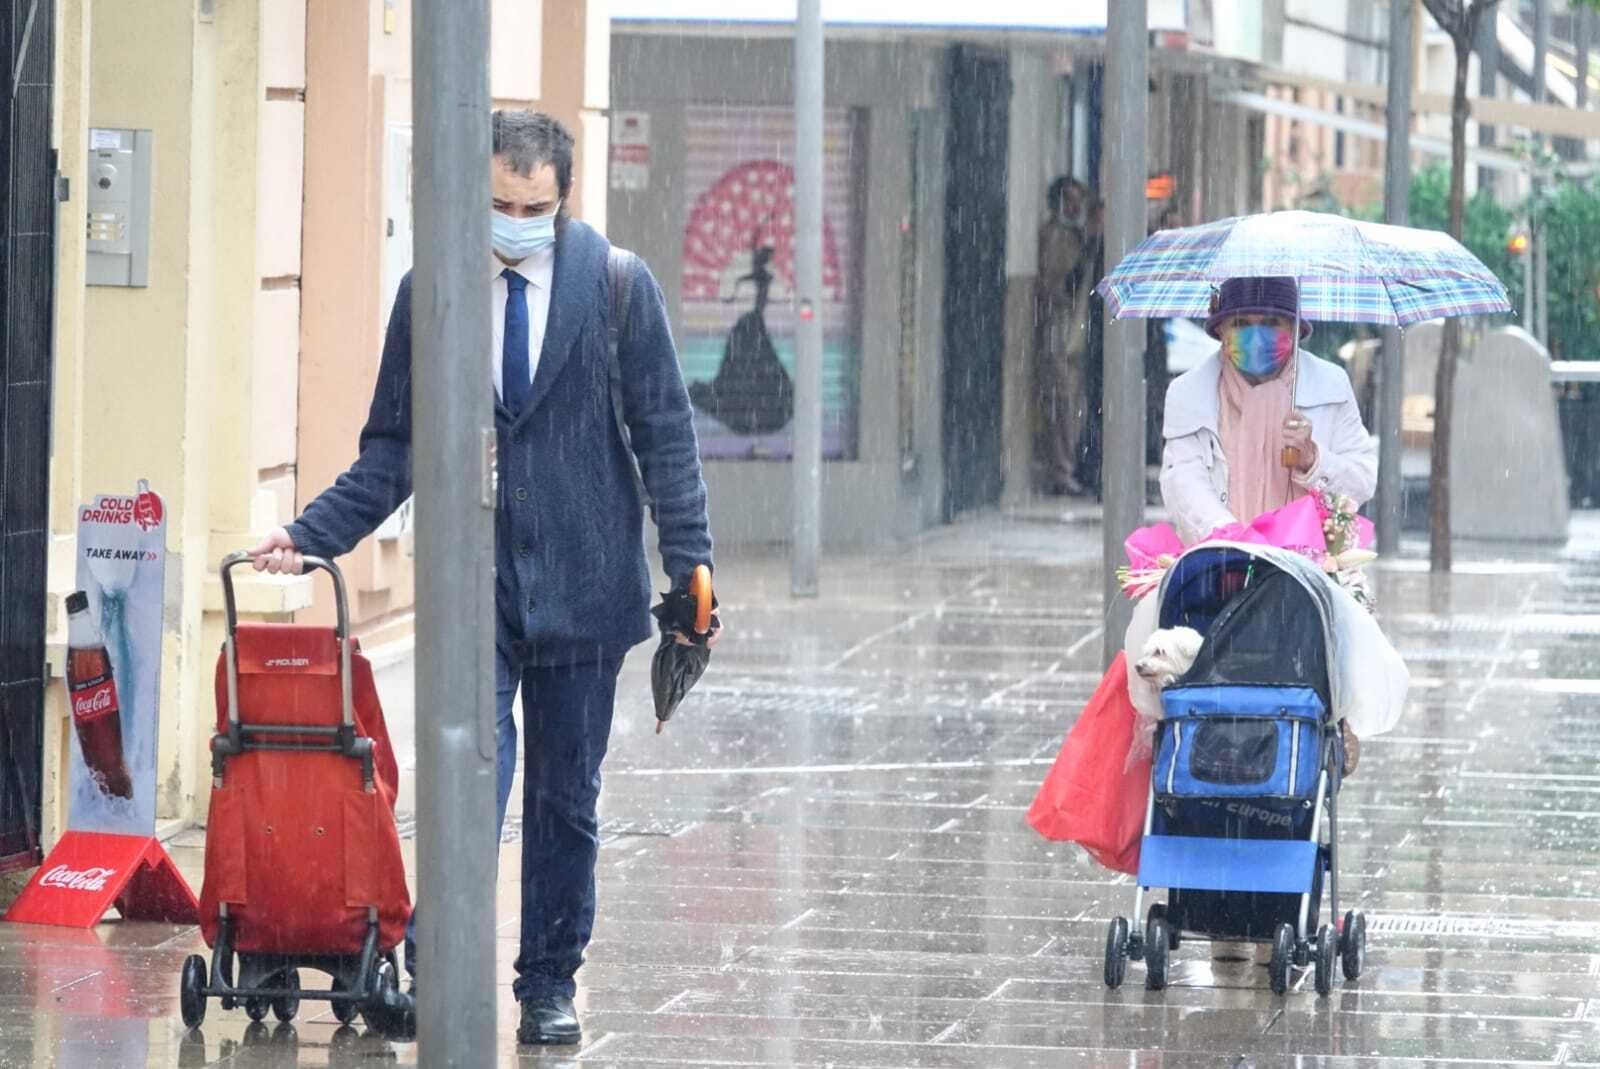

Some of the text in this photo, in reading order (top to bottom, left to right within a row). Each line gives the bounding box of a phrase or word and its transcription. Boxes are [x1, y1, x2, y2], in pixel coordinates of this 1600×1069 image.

[100, 498, 134, 511] COLD
[82, 509, 132, 524] DRINKS
[86, 548, 146, 561] TAKE AWAY
[39, 864, 116, 891] Coca-Cola
